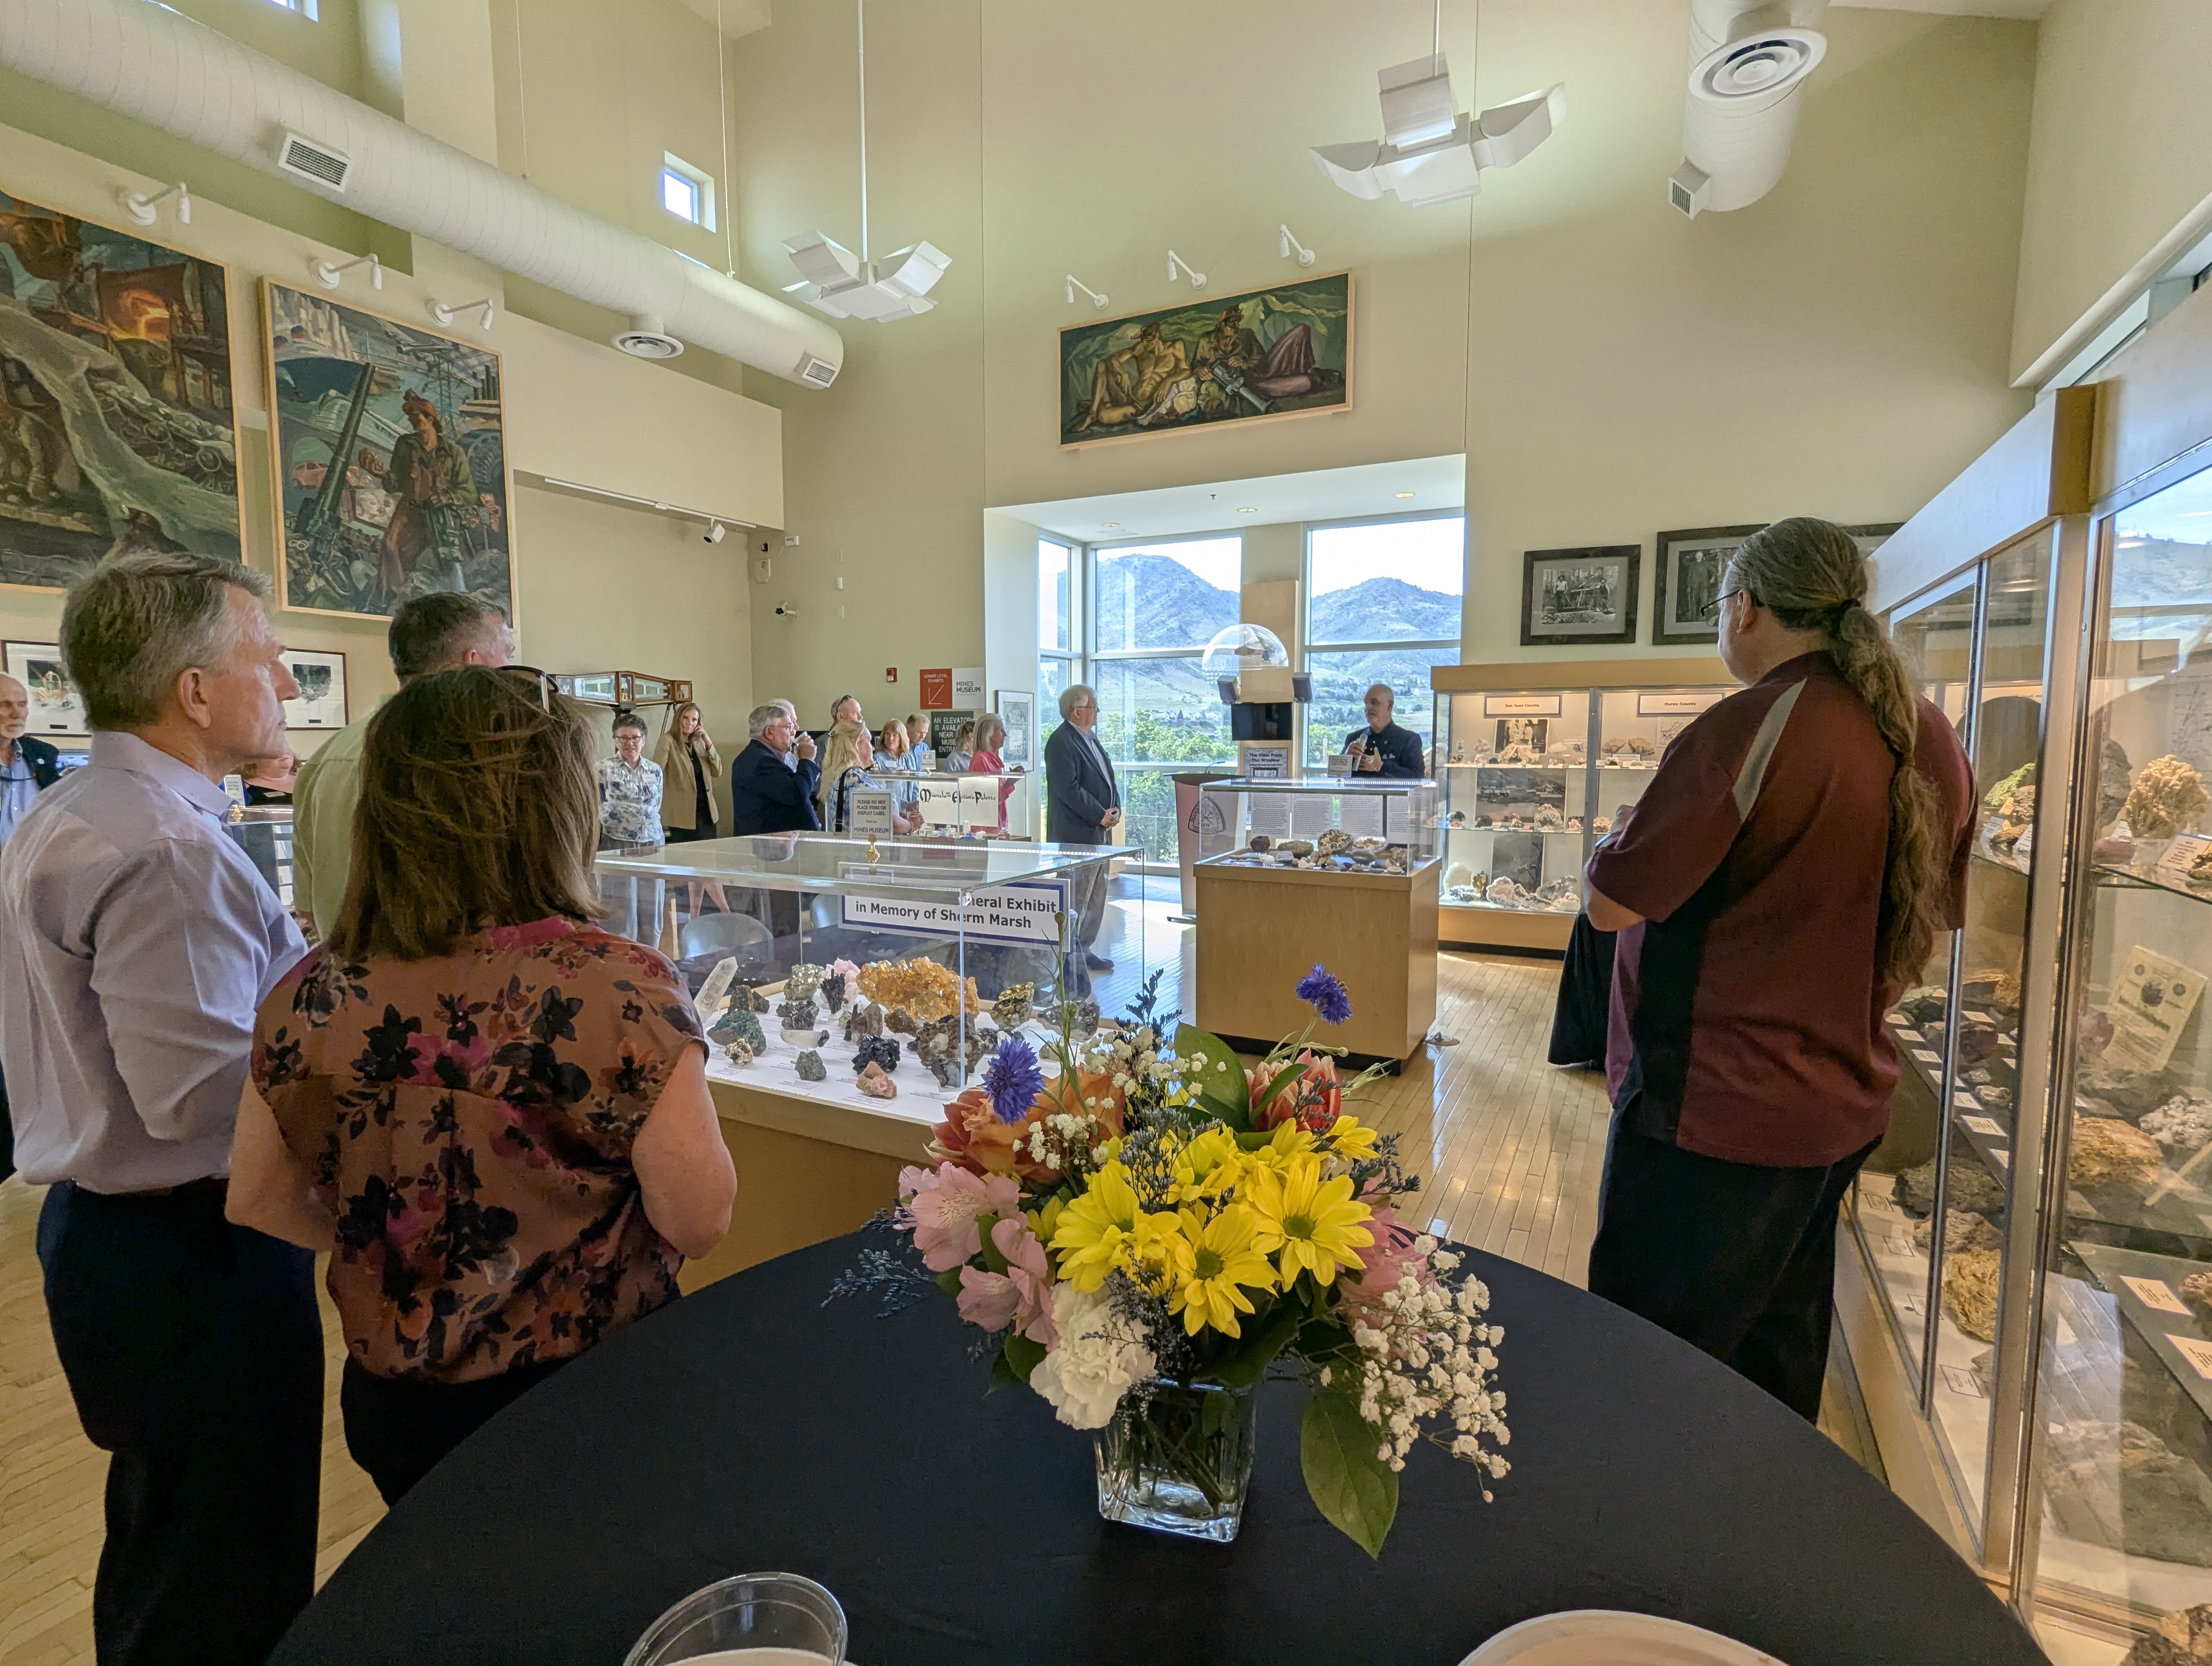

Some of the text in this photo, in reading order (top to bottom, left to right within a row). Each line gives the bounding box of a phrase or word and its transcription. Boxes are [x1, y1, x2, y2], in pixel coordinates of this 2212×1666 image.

[974, 791, 996, 805] Palette
[968, 896, 1056, 913] neral Exhibit
[856, 901, 1031, 928] in Memory of Sherm Marsh
